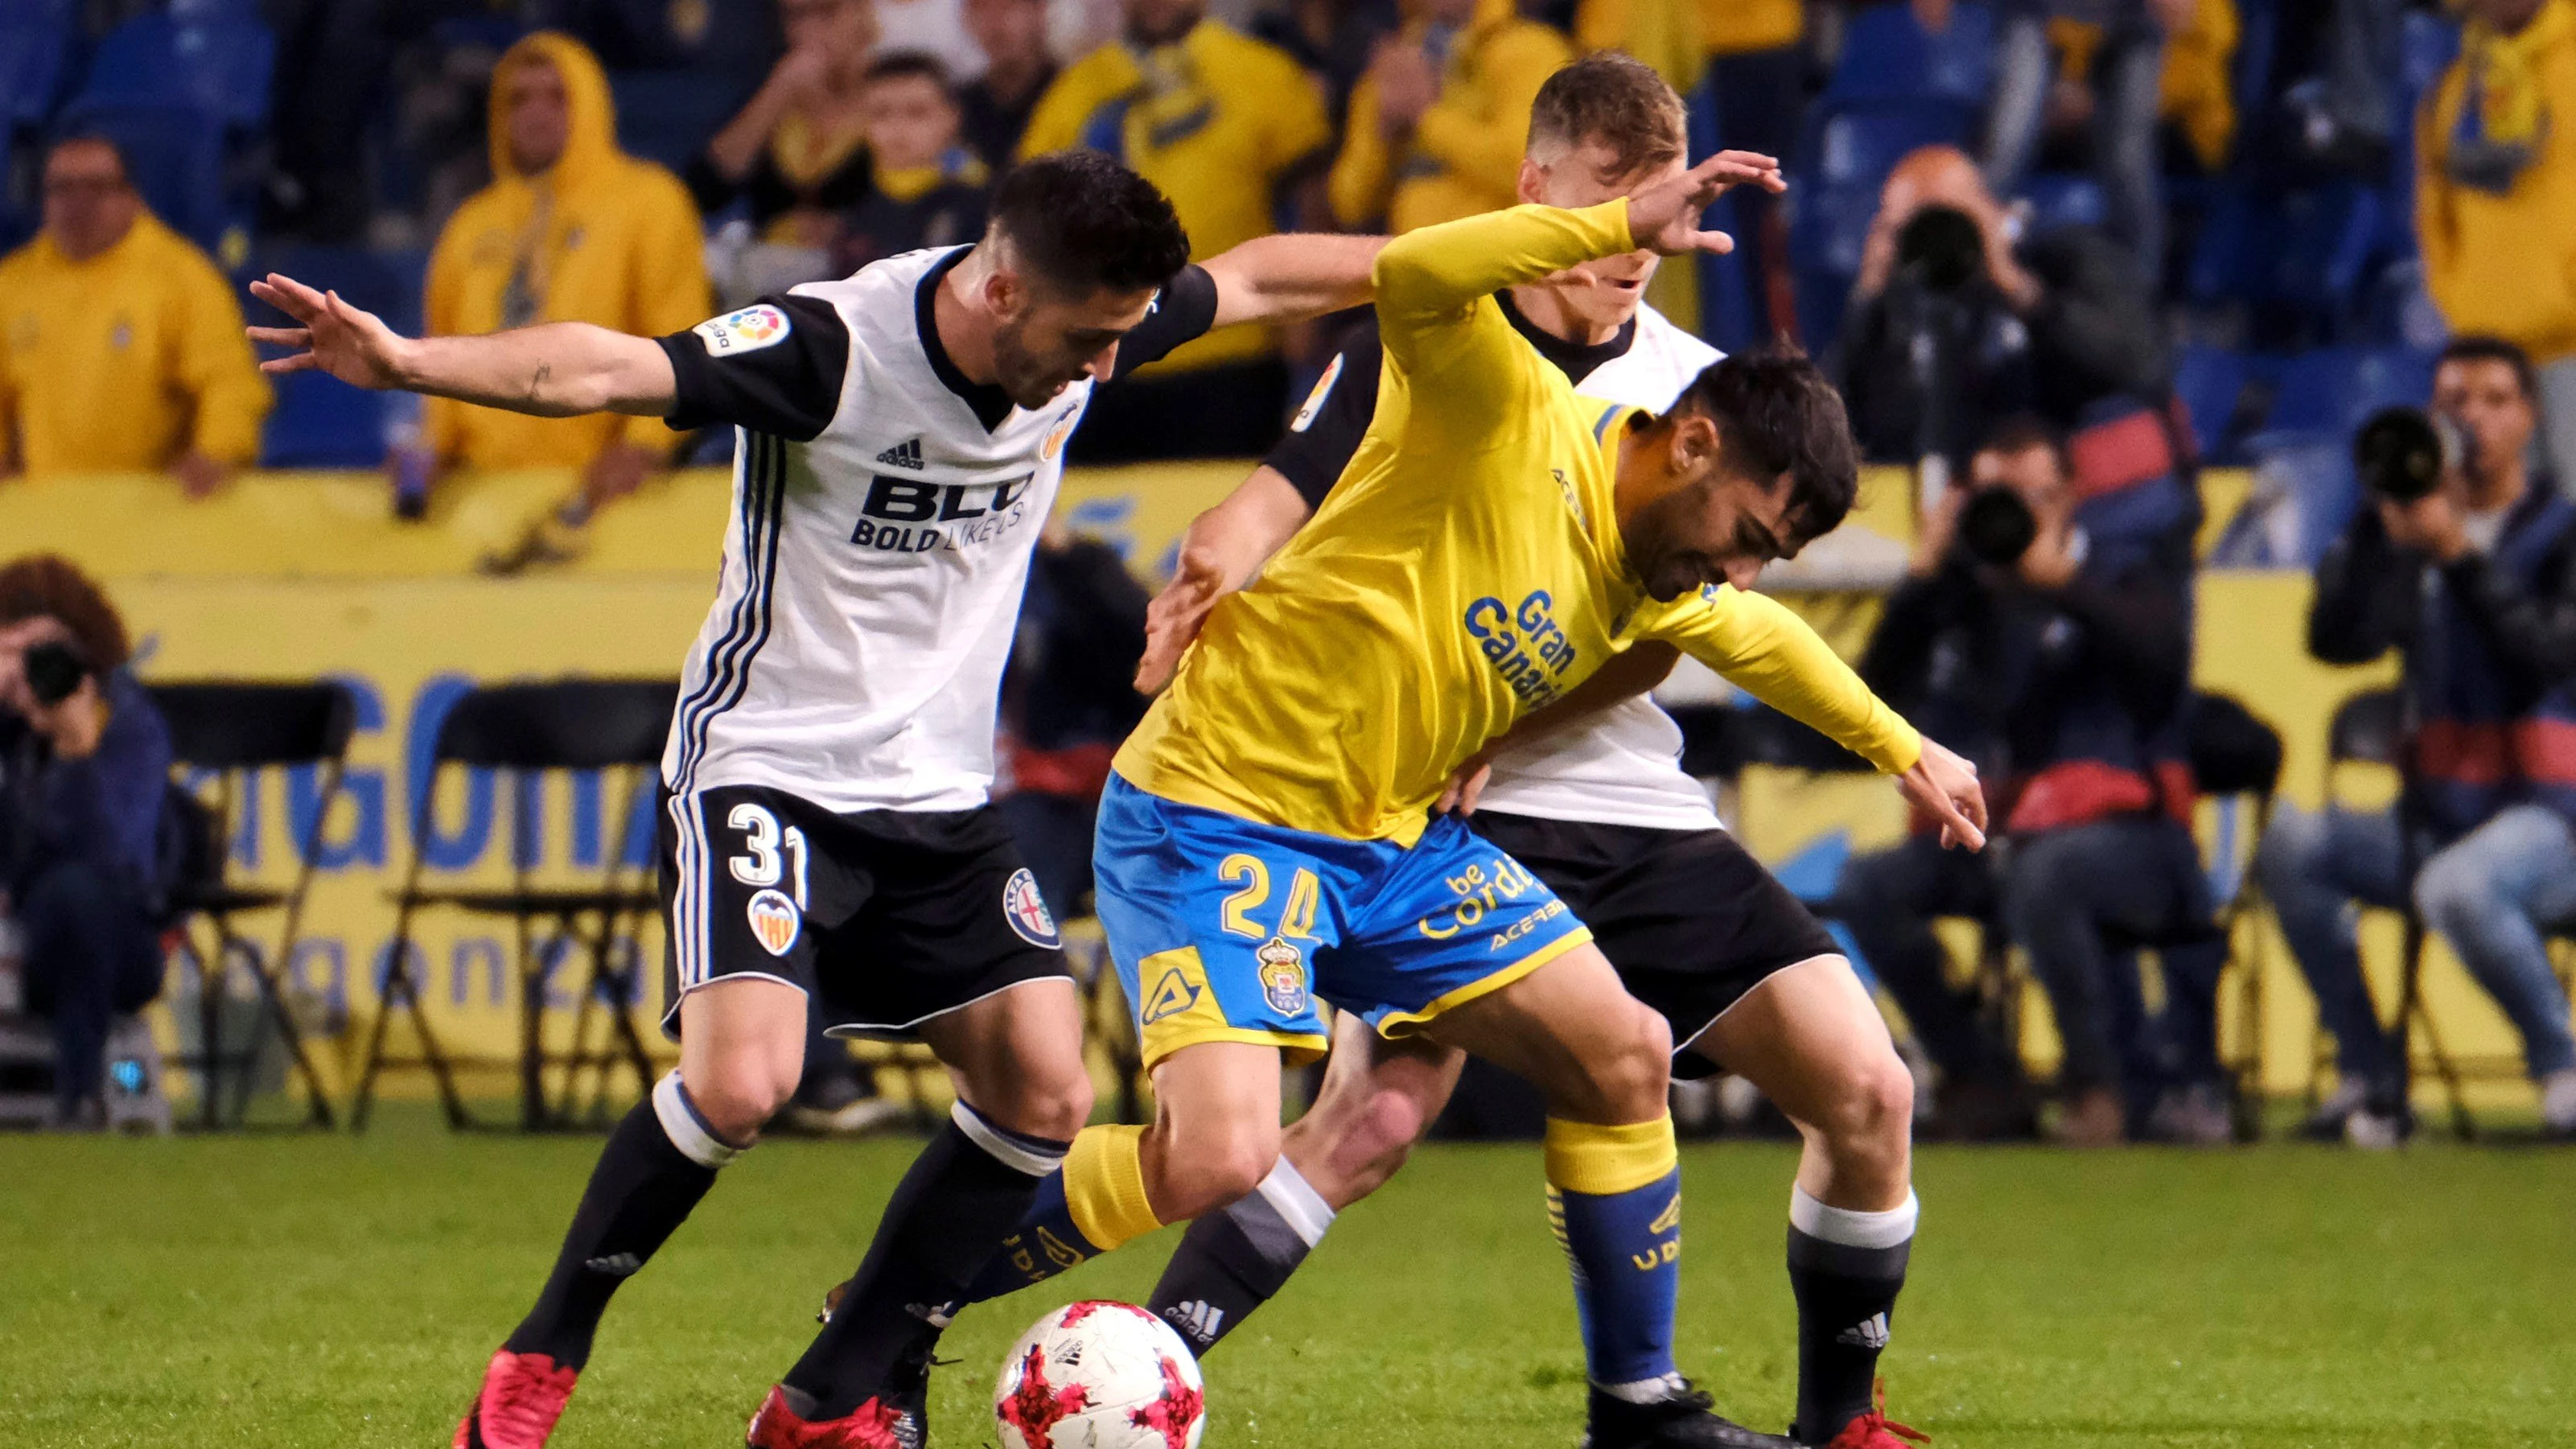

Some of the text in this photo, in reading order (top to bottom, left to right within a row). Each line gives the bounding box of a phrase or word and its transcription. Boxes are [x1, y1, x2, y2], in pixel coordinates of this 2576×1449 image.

[875, 452, 925, 471] adidas
[850, 518, 940, 554] BOLD
[943, 517, 997, 552] LIKE
[1516, 590, 1576, 676] Gran
[727, 803, 808, 912] 31
[1445, 863, 1485, 895] be
[1218, 853, 1323, 945] 24
